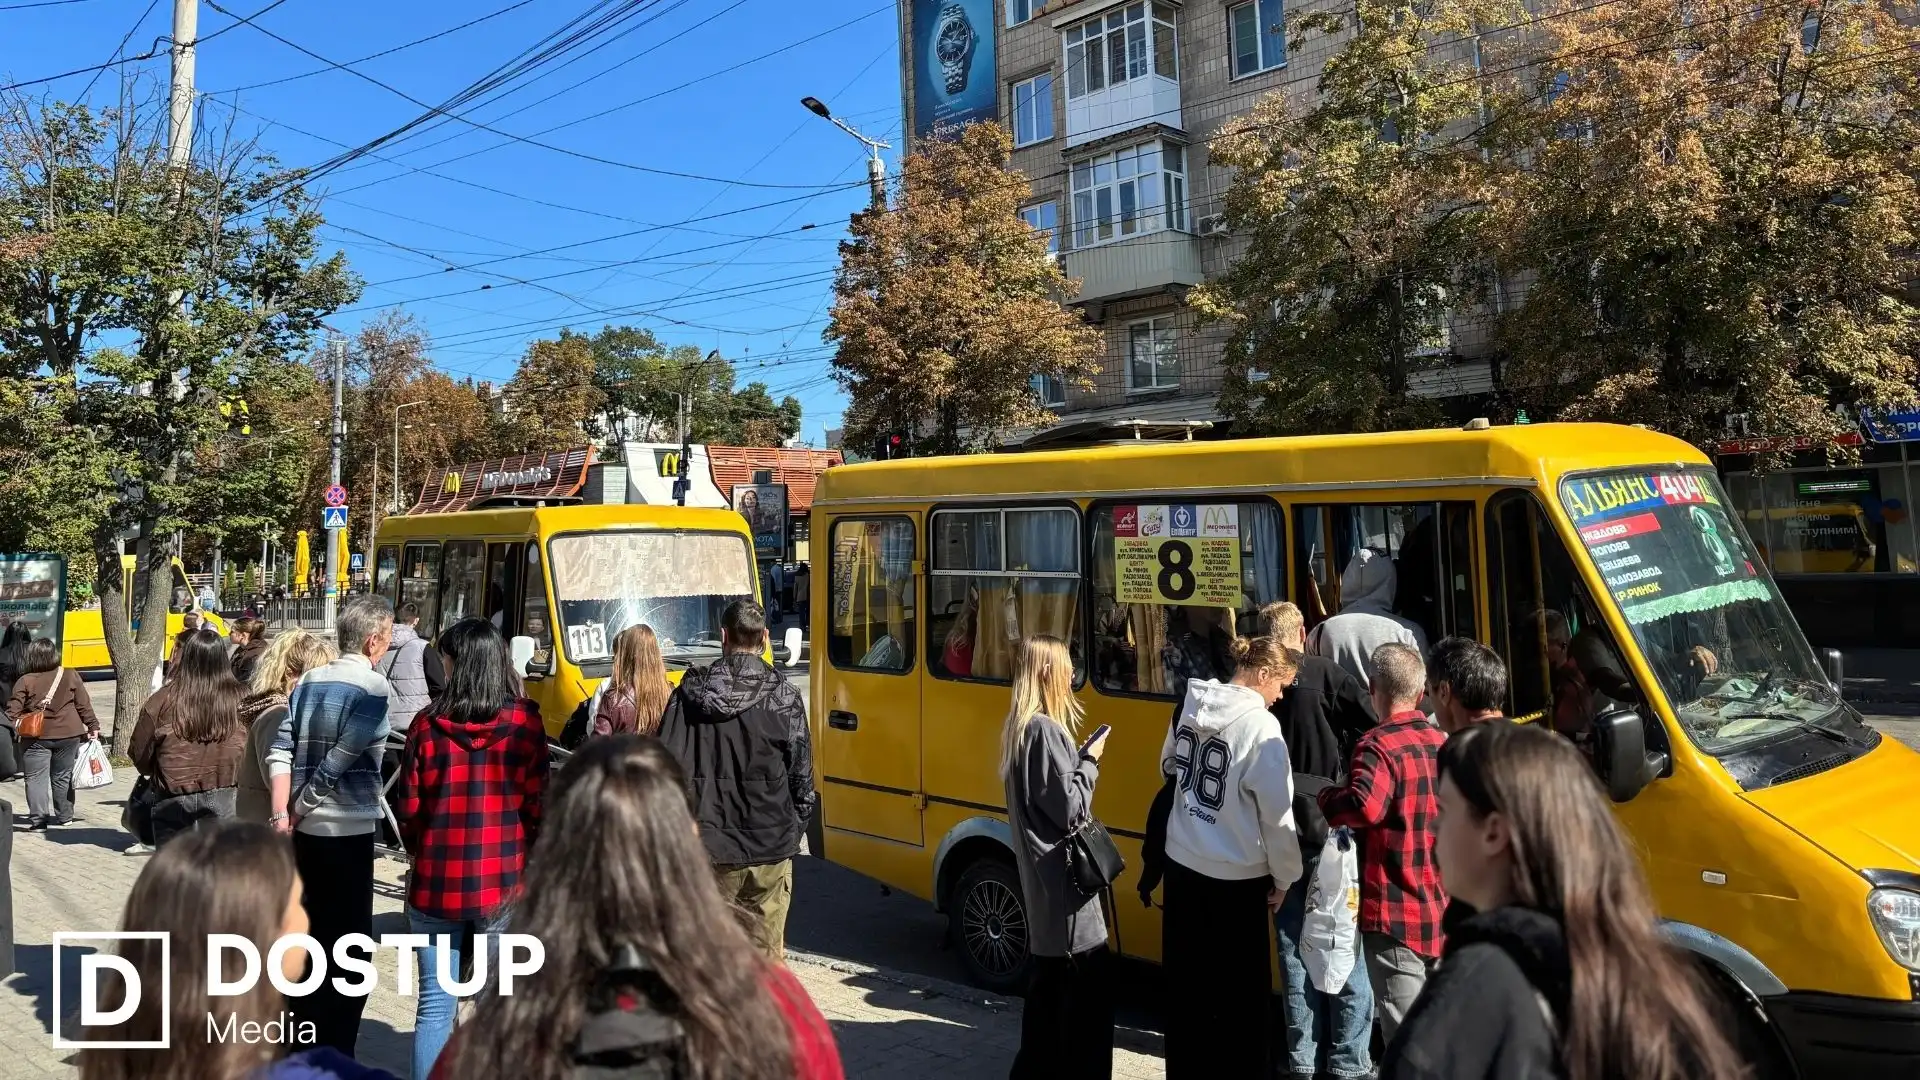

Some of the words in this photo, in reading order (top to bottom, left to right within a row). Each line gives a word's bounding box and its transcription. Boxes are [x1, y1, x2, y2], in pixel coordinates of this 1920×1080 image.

[1565, 473, 1659, 520] АЛЬЯНС
[1157, 540, 1196, 601] 8
[572, 627, 604, 655] 113
[1175, 724, 1232, 812] 98
